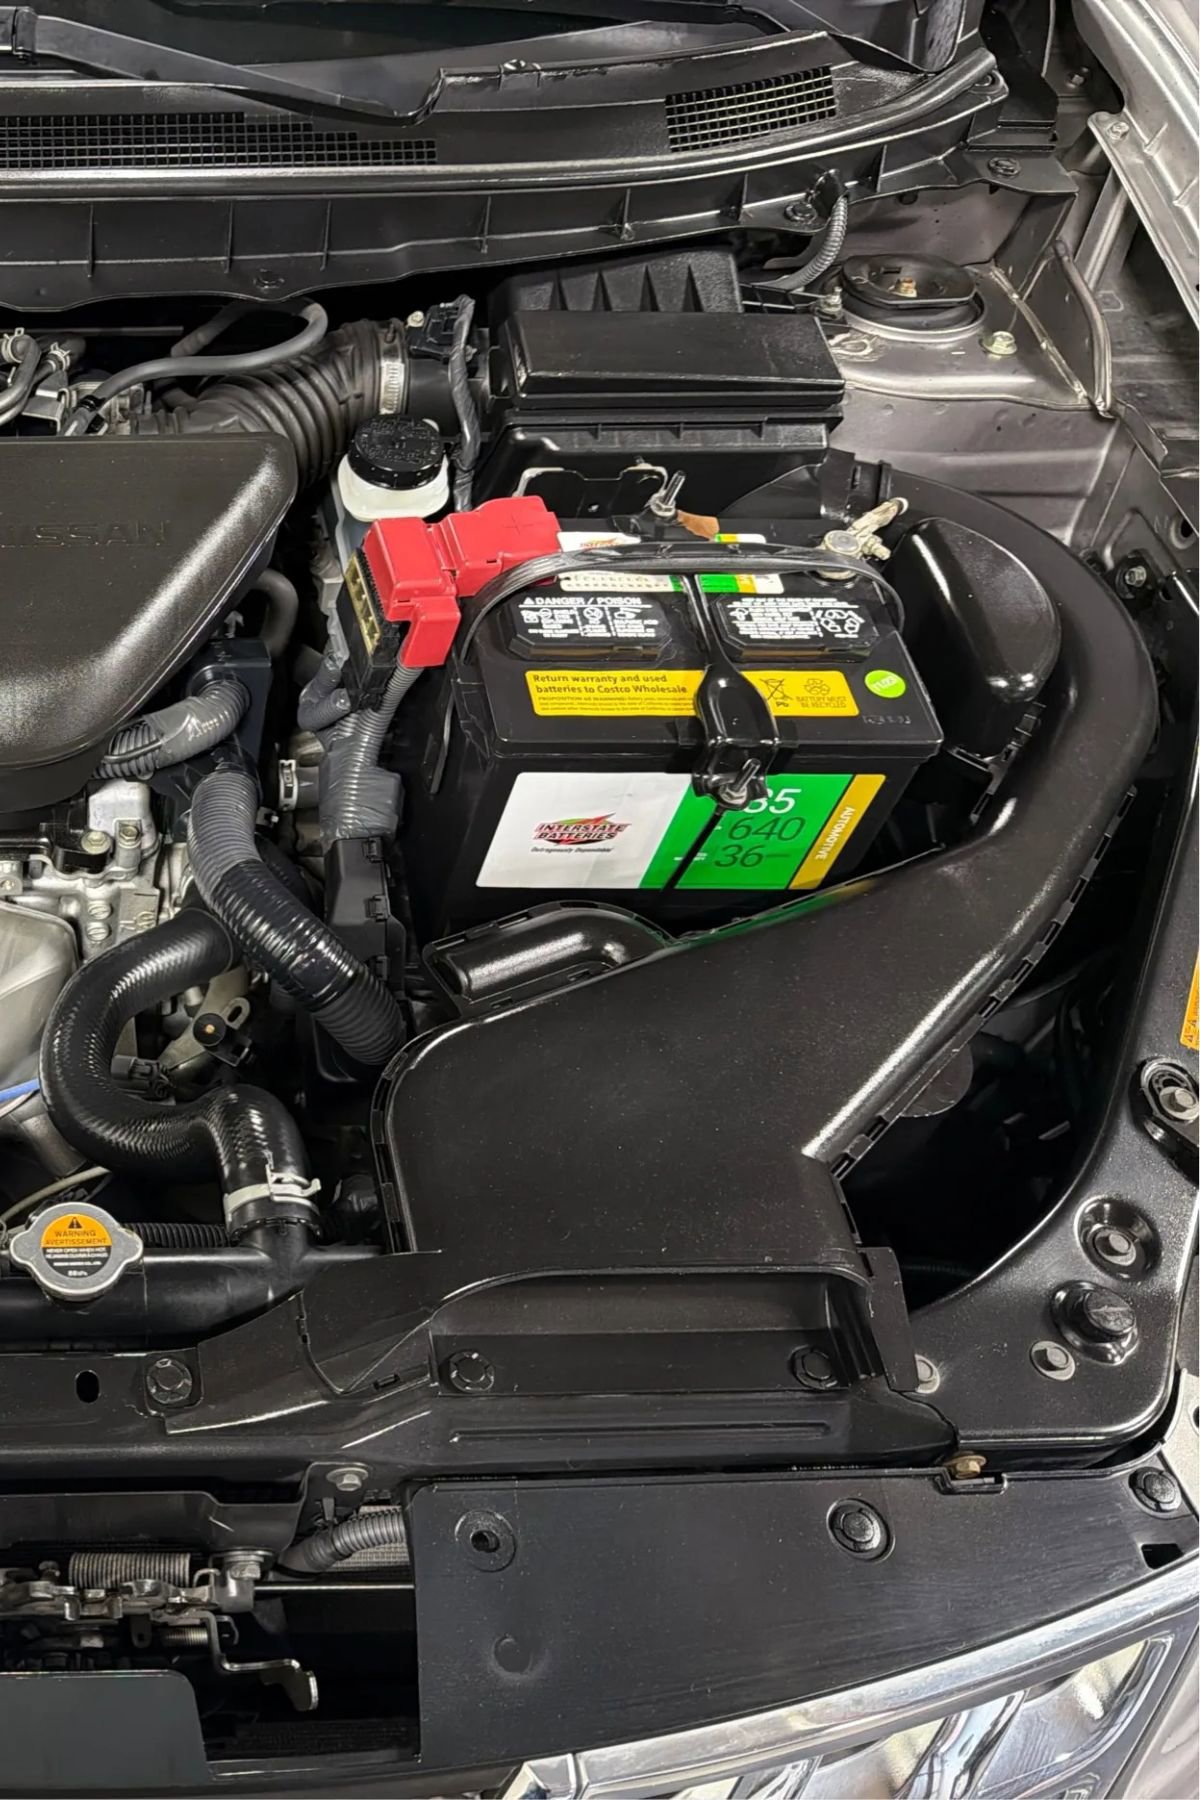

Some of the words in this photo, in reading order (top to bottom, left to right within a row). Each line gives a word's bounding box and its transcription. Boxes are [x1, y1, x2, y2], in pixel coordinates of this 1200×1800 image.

[535, 597, 584, 605] DANGER
[597, 597, 642, 605] POISON
[533, 675, 569, 683] Return
[571, 675, 618, 684] warranty
[620, 674, 640, 682] and
[643, 674, 668, 682] used
[536, 685, 582, 693] batteries
[584, 685, 595, 693] to
[597, 685, 631, 693] Costco
[632, 685, 688, 693] Wholesale
[535, 823, 630, 832] INTERSTATE
[728, 816, 806, 841] 640
[535, 832, 617, 840] BATTERIES
[815, 807, 856, 860] AUTOMOTIVE
